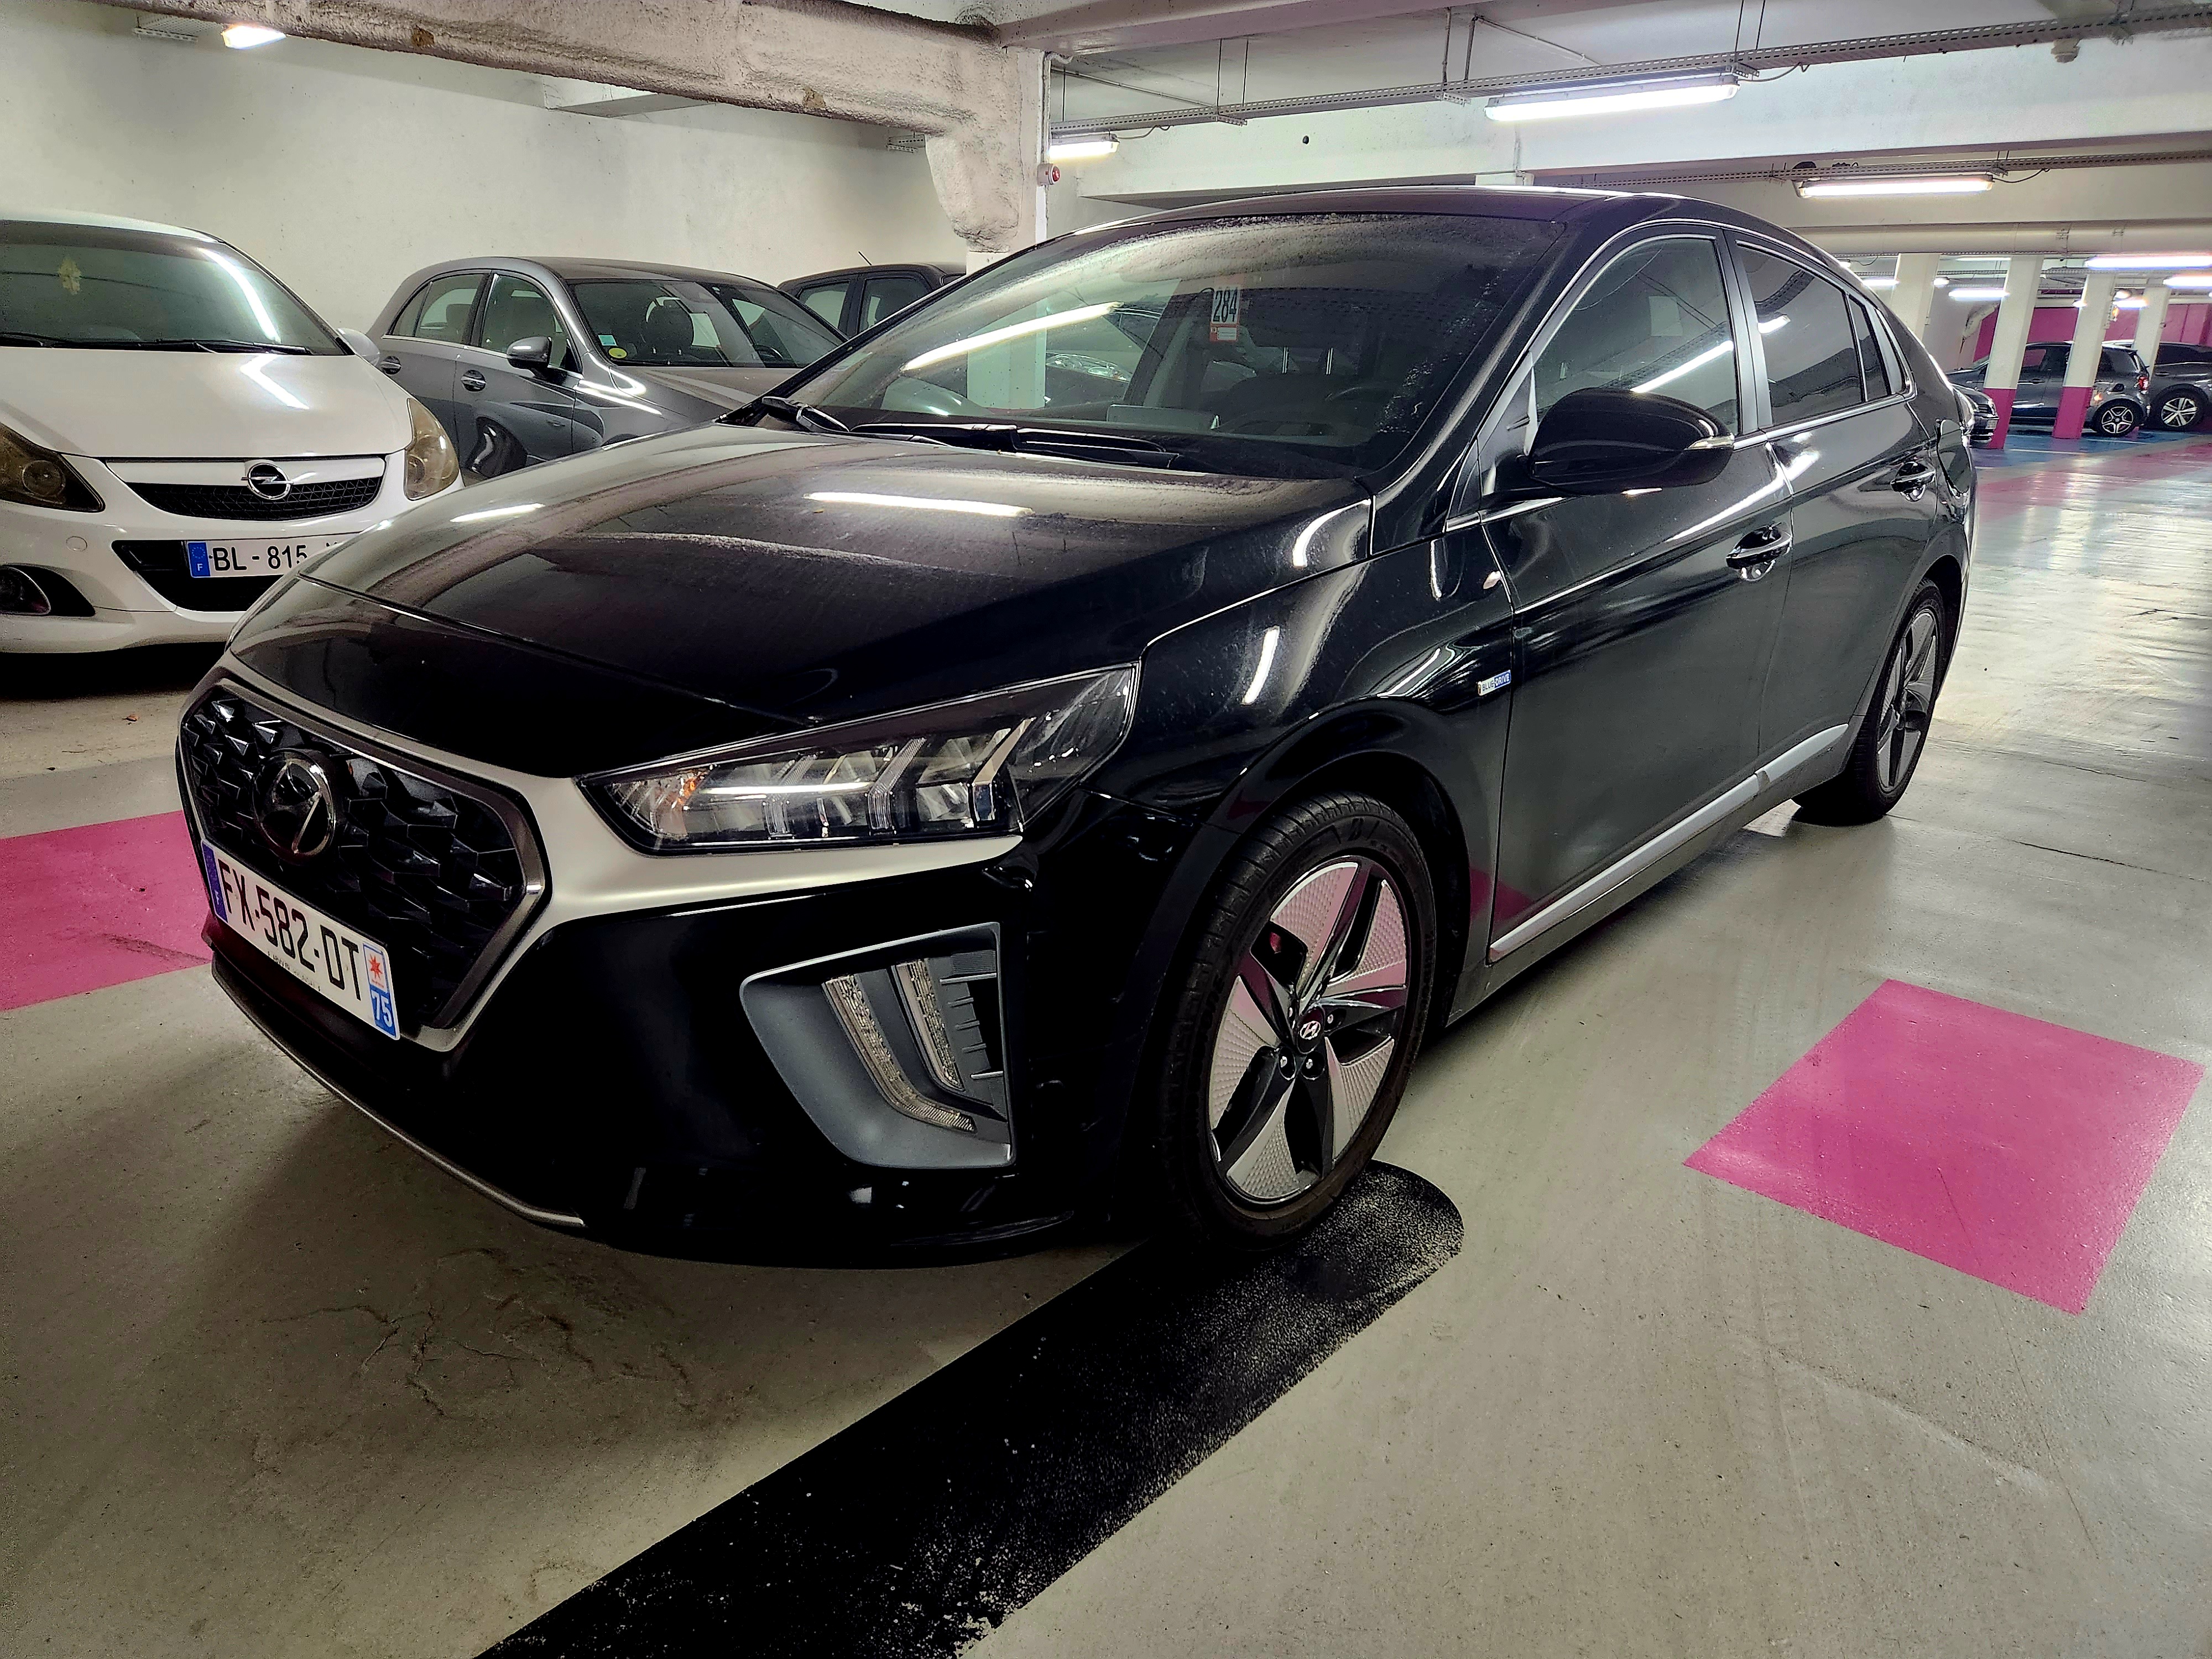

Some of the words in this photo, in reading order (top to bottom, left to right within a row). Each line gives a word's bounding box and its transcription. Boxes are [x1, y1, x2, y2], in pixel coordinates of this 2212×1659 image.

[1213, 288, 1238, 322] 284
[197, 563, 203, 571] F
[218, 859, 361, 1001] FX-582-DT
[371, 989, 393, 1027] 75
